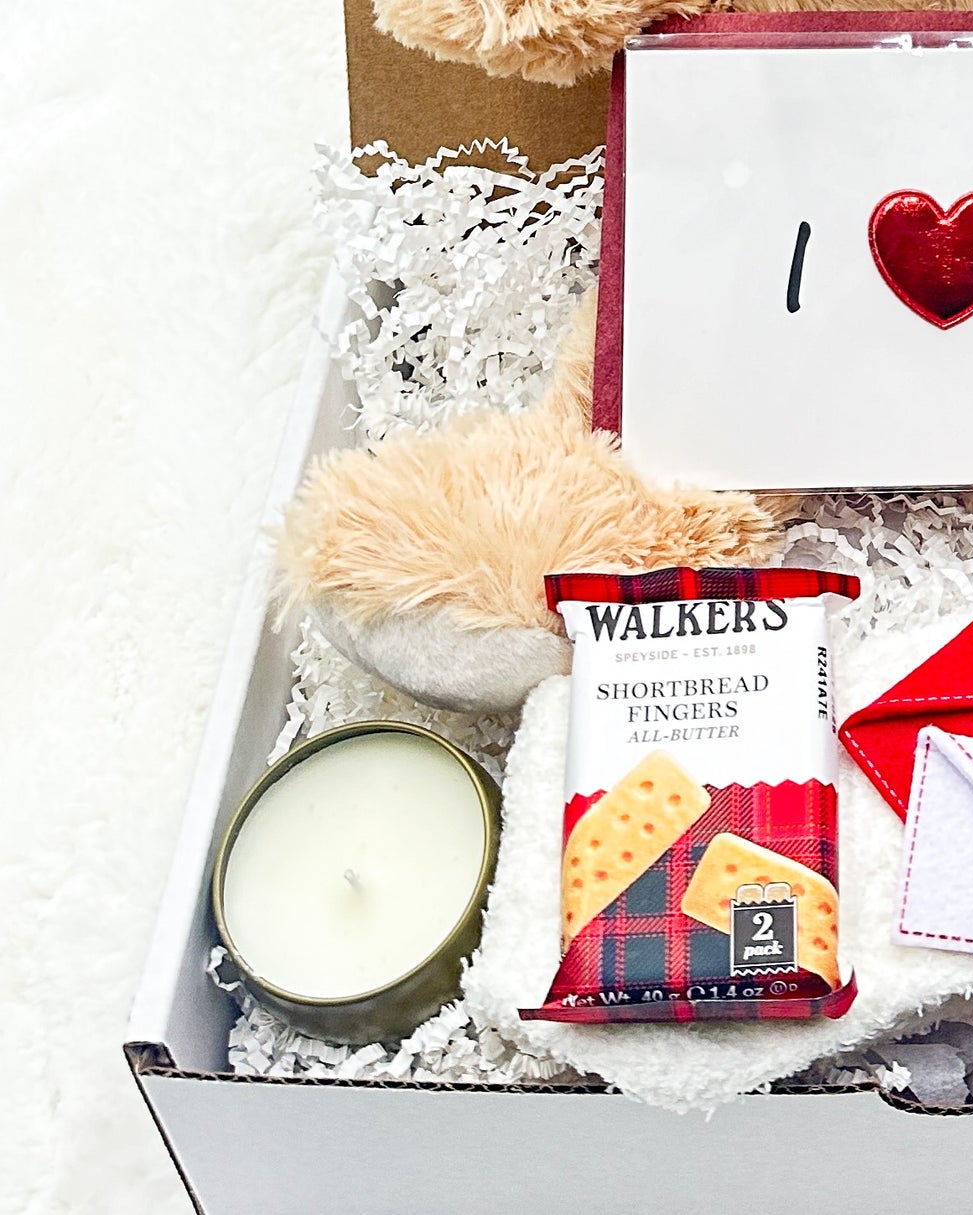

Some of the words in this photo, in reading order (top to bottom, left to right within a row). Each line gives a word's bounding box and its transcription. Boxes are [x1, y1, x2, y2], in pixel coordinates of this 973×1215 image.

[786, 220, 811, 314] I
[585, 597, 788, 642] WALKERS
[615, 649, 679, 663] SPEYSIDE
[693, 646, 723, 658] EST.
[726, 644, 757, 657] 1898
[596, 674, 769, 701] SHORTBREAD
[627, 700, 739, 723] FINGERS
[627, 724, 740, 744] ALL-BUTTER
[751, 911, 774, 941] 2
[742, 940, 784, 961] pack
[641, 989, 664, 1002] 40
[709, 984, 738, 999] 1.4
[742, 986, 765, 998] oz
